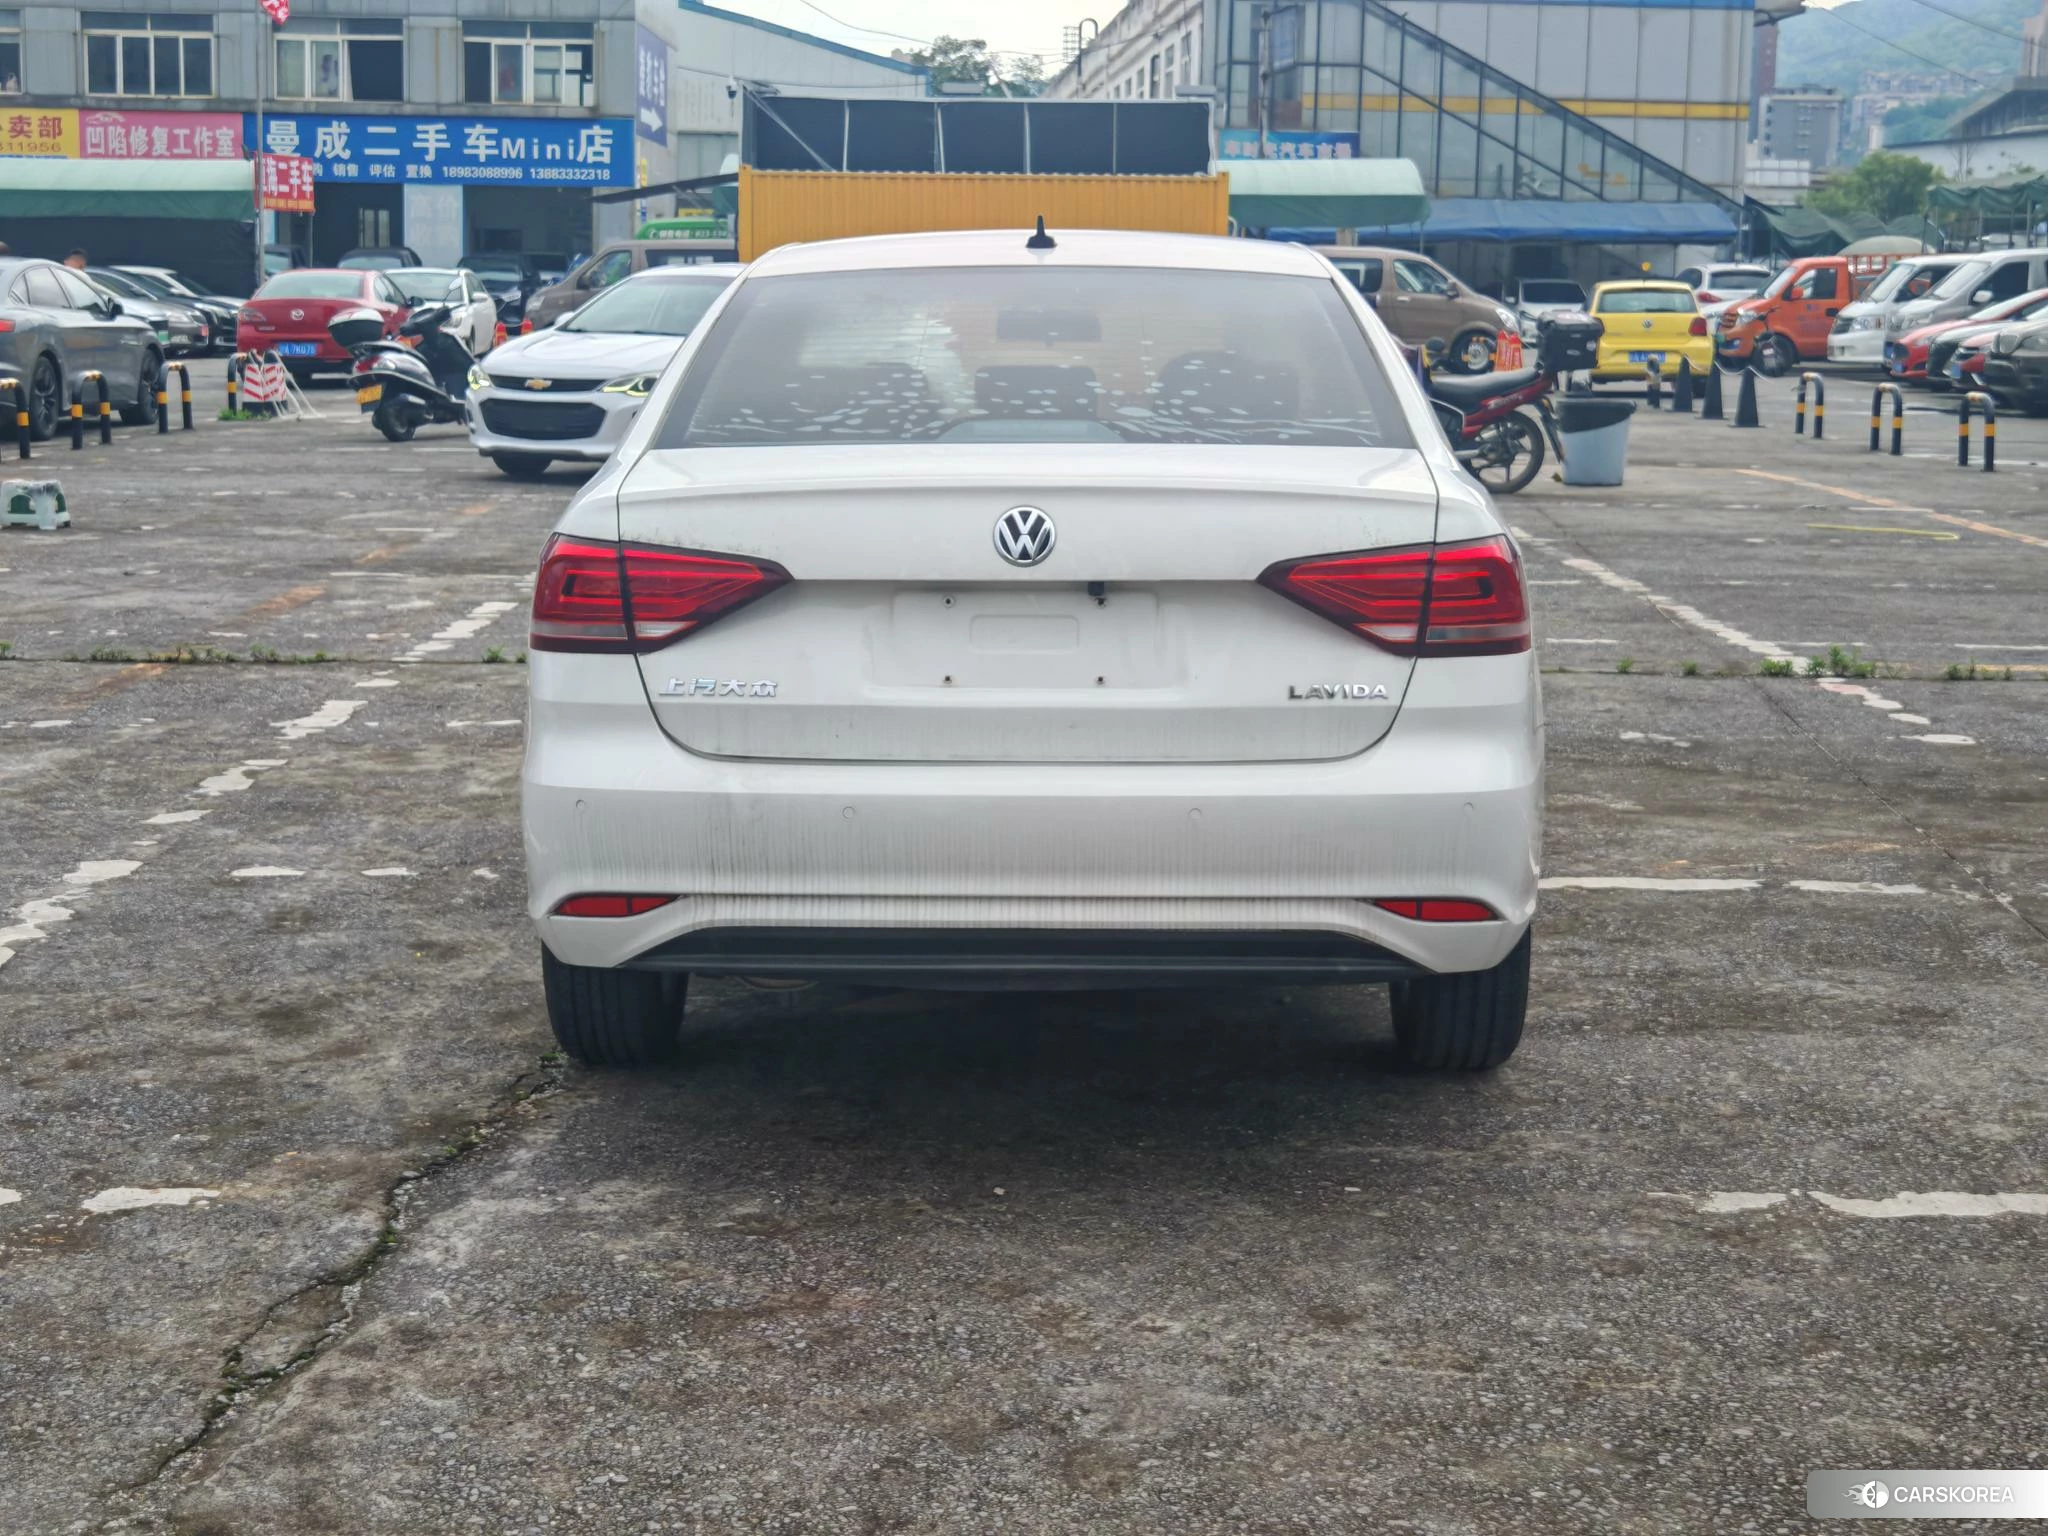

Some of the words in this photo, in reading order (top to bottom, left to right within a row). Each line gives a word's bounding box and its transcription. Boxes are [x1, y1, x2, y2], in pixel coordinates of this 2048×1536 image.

[0, 115, 63, 139] 卖部
[86, 126, 235, 157] 凹陷修复工作室
[333, 163, 359, 177] 销售
[370, 164, 396, 178] 评估
[406, 164, 432, 179] 置换
[658, 678, 778, 697] 上汽大众
[1288, 684, 1389, 700] LAVIDA
